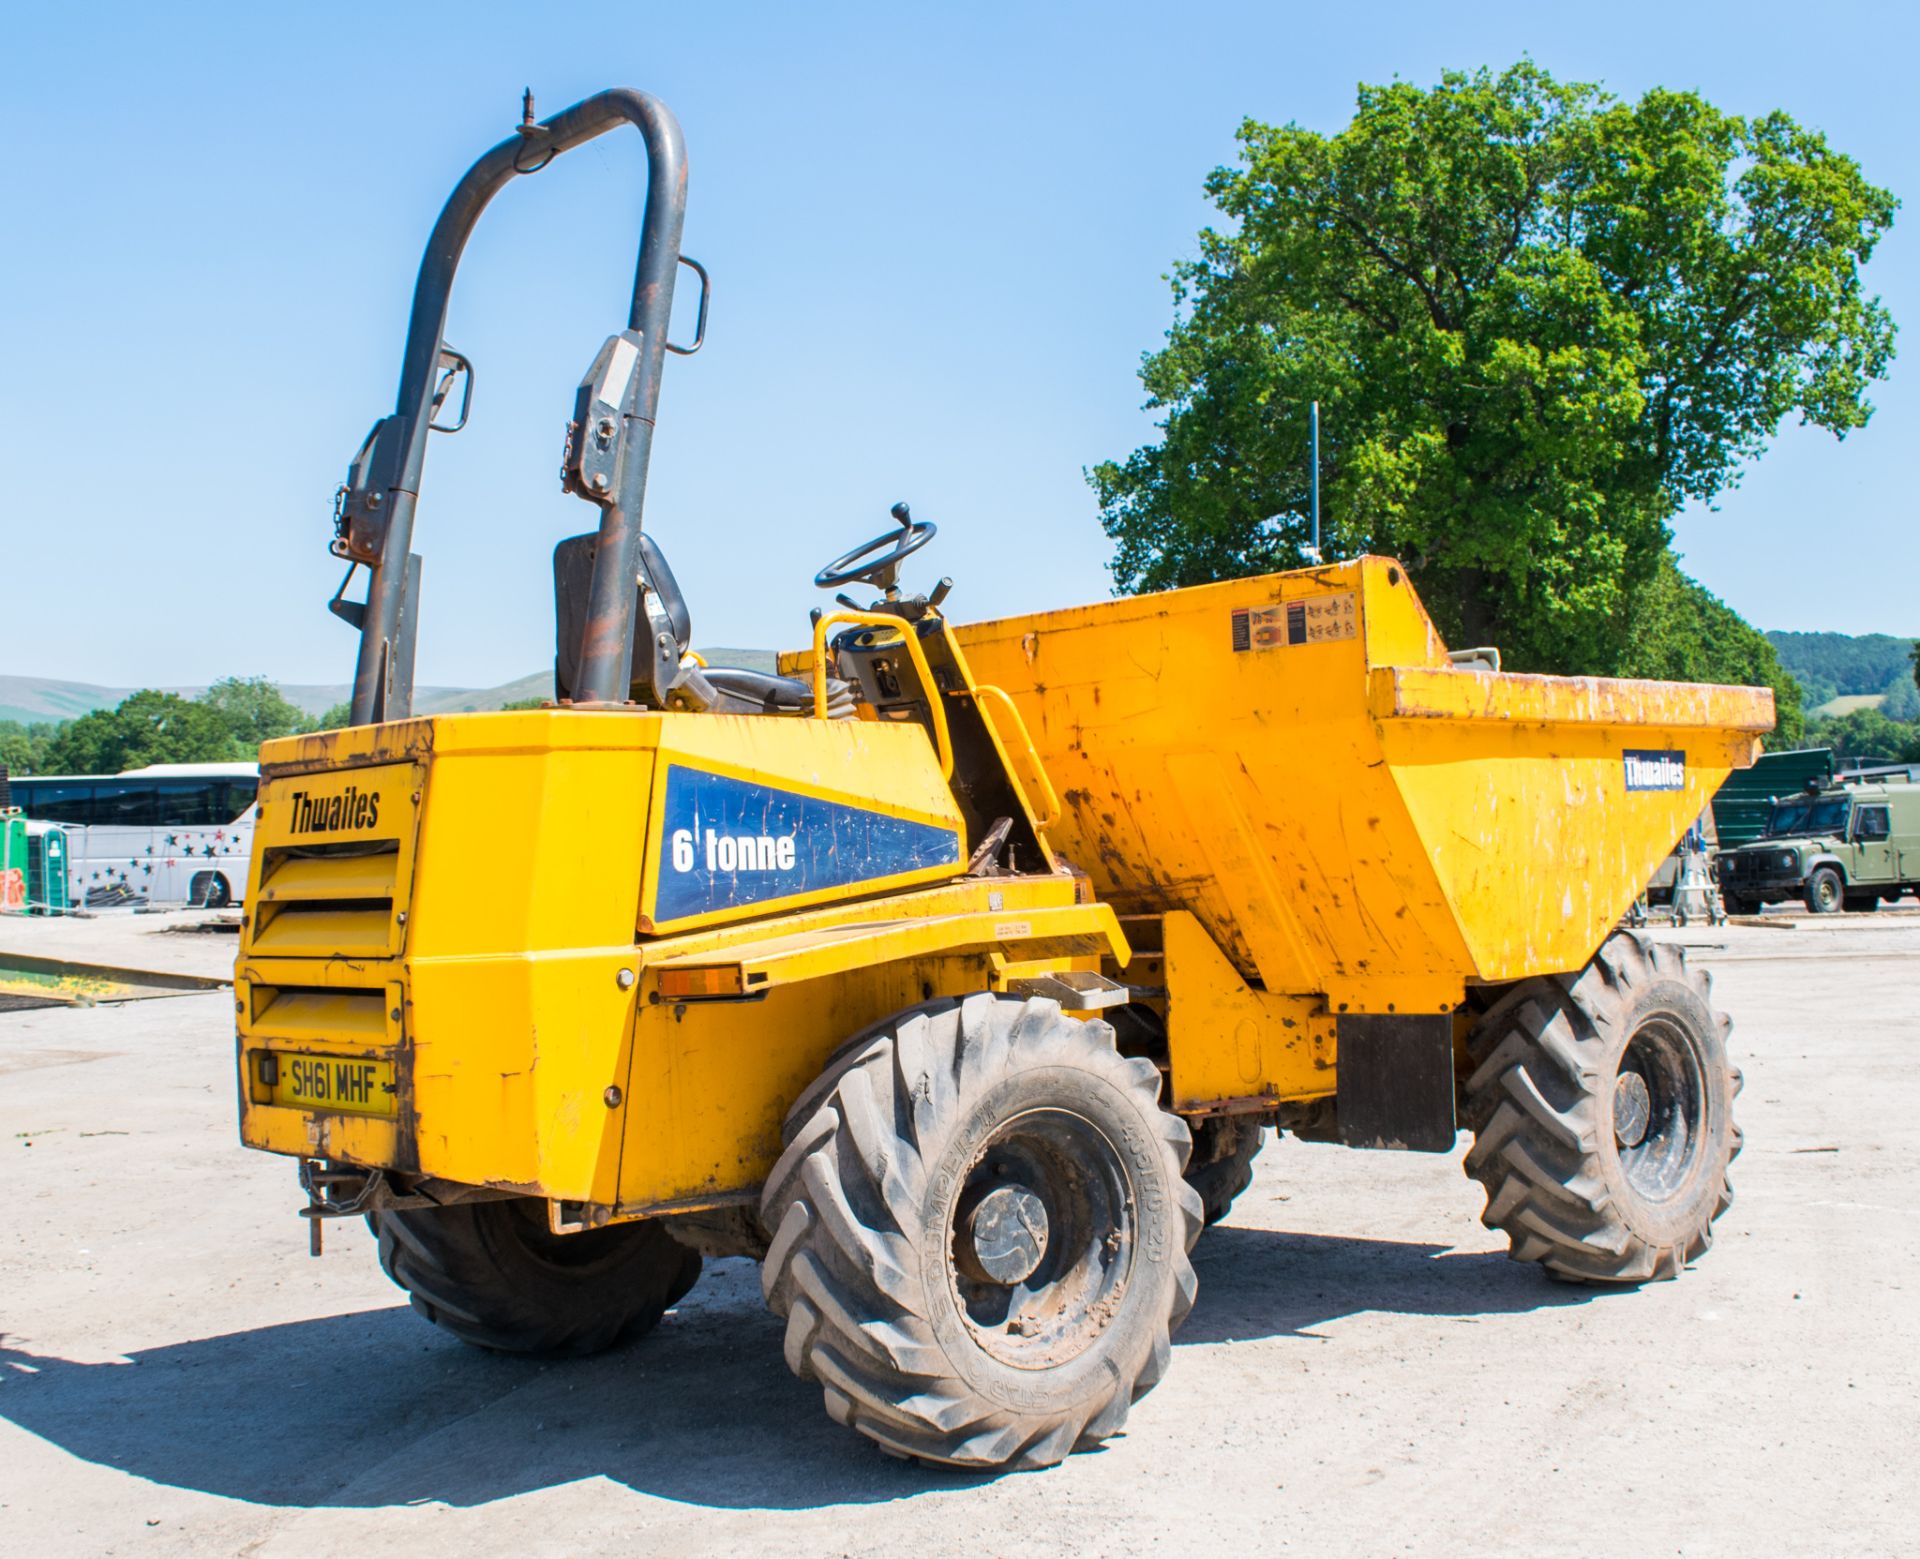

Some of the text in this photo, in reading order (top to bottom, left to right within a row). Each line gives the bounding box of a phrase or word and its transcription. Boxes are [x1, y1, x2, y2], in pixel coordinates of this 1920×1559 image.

[1625, 756, 1684, 786] Thwaites
[290, 786, 381, 834] Thwaites
[672, 828, 796, 872] 6 tonne
[292, 1060, 376, 1103] SH61 MHF
[925, 1128, 975, 1283] DUMPER
